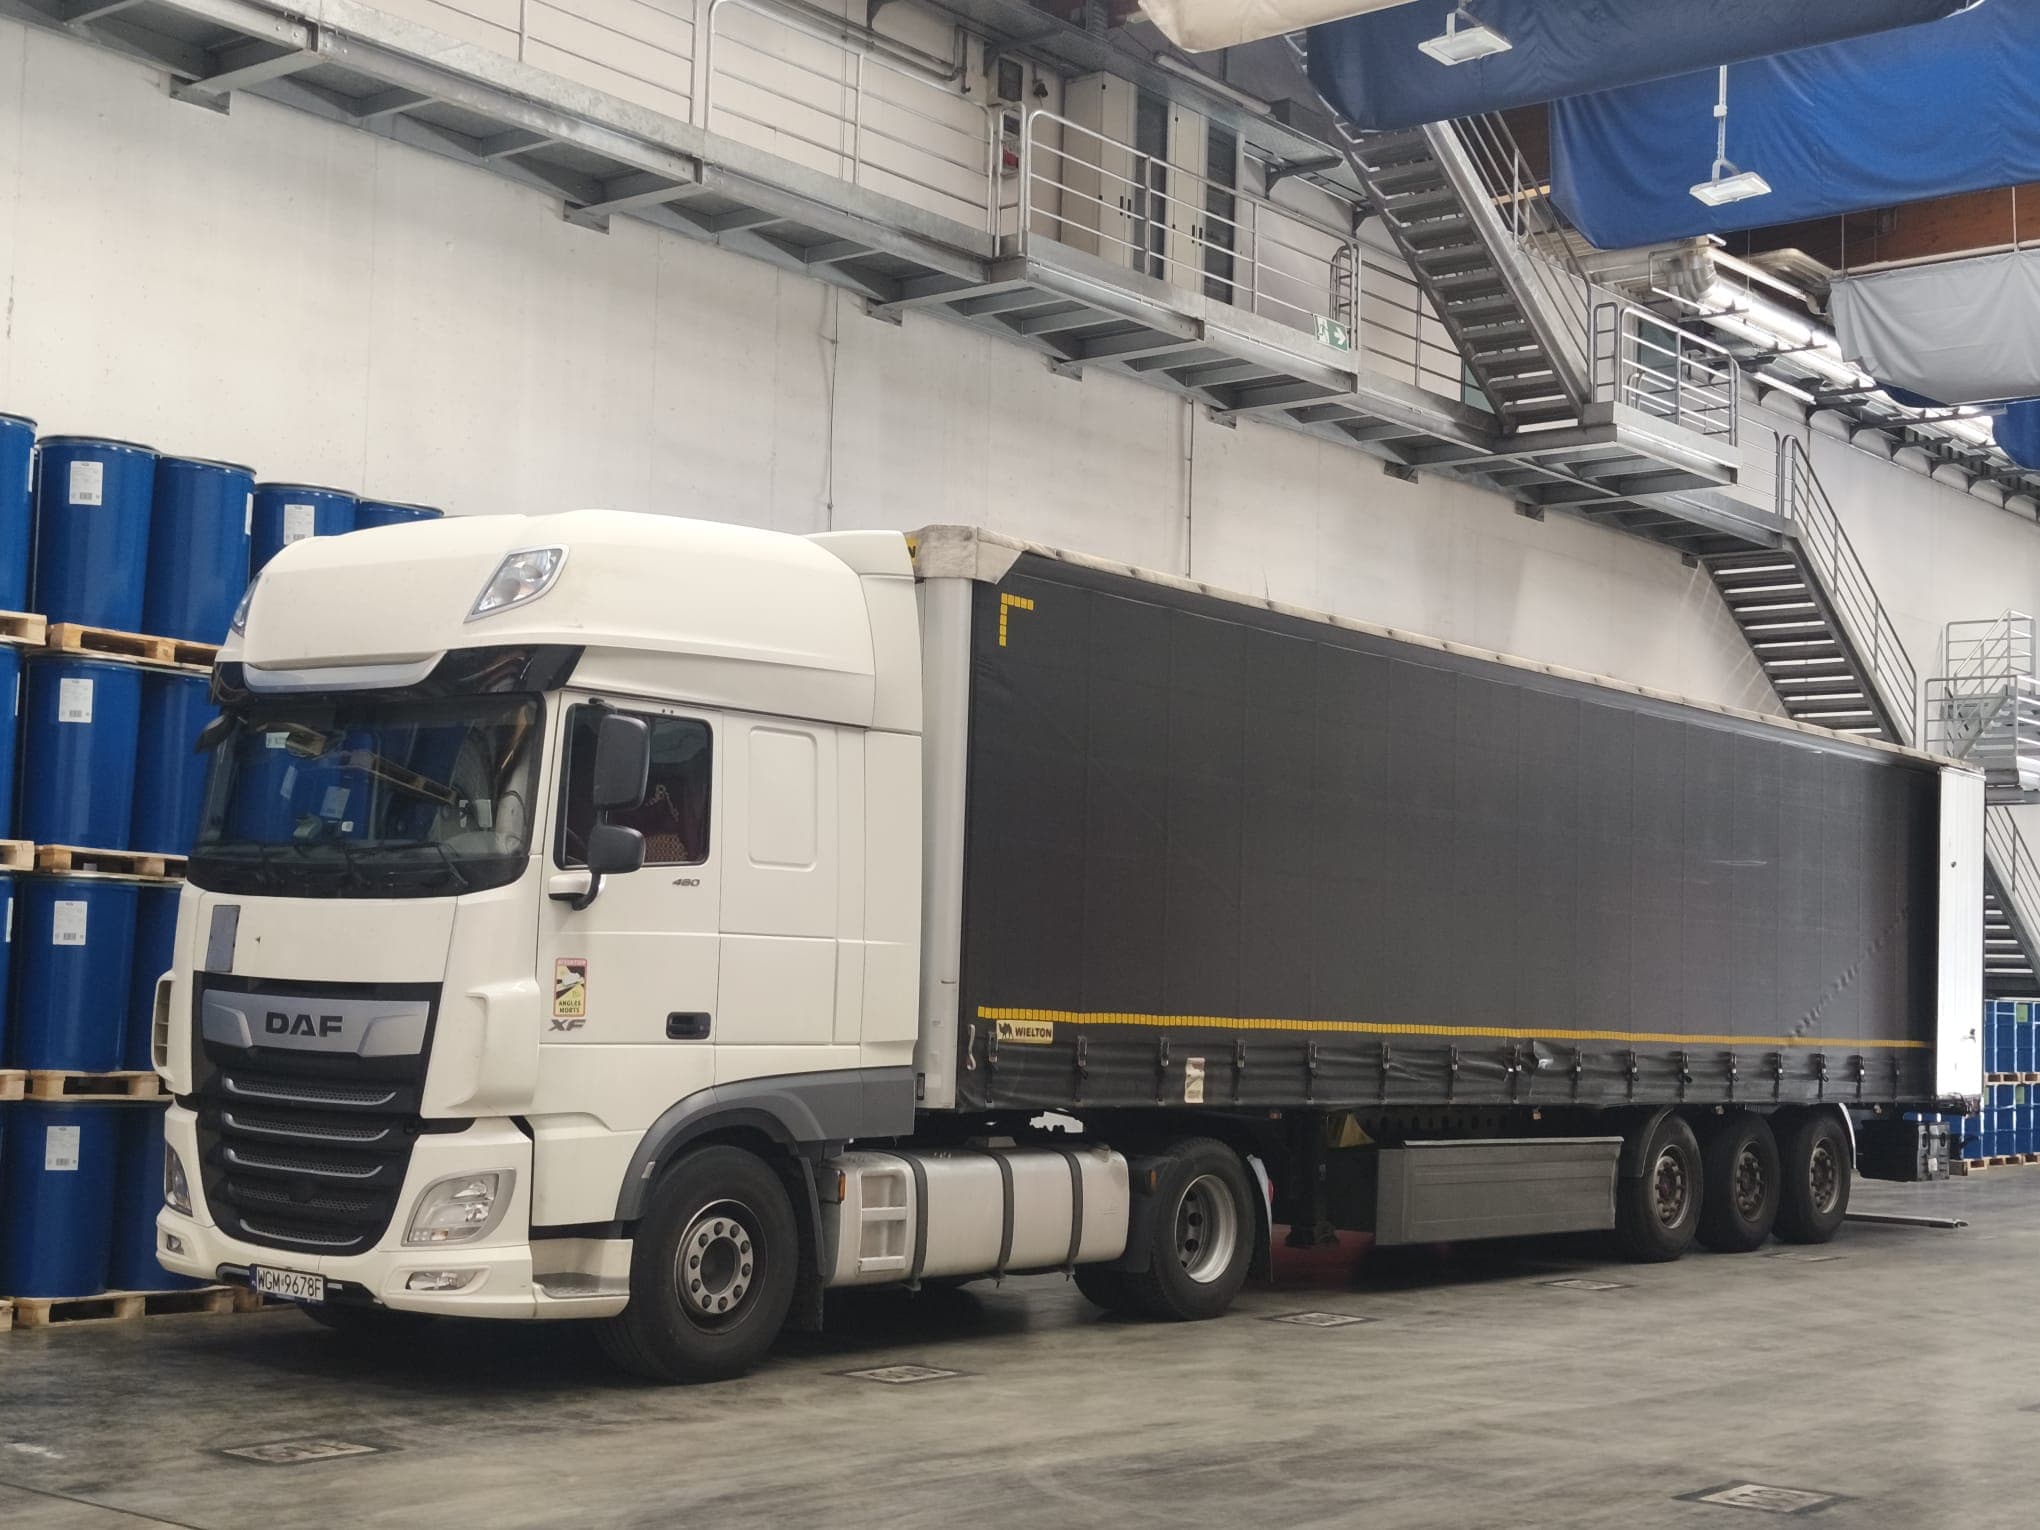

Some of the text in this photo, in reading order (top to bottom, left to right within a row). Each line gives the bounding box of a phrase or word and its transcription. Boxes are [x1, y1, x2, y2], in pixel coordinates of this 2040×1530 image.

[265, 1012, 343, 1038] DAF
[548, 1019, 586, 1031] XF
[1015, 1026, 1052, 1038] WIELTON
